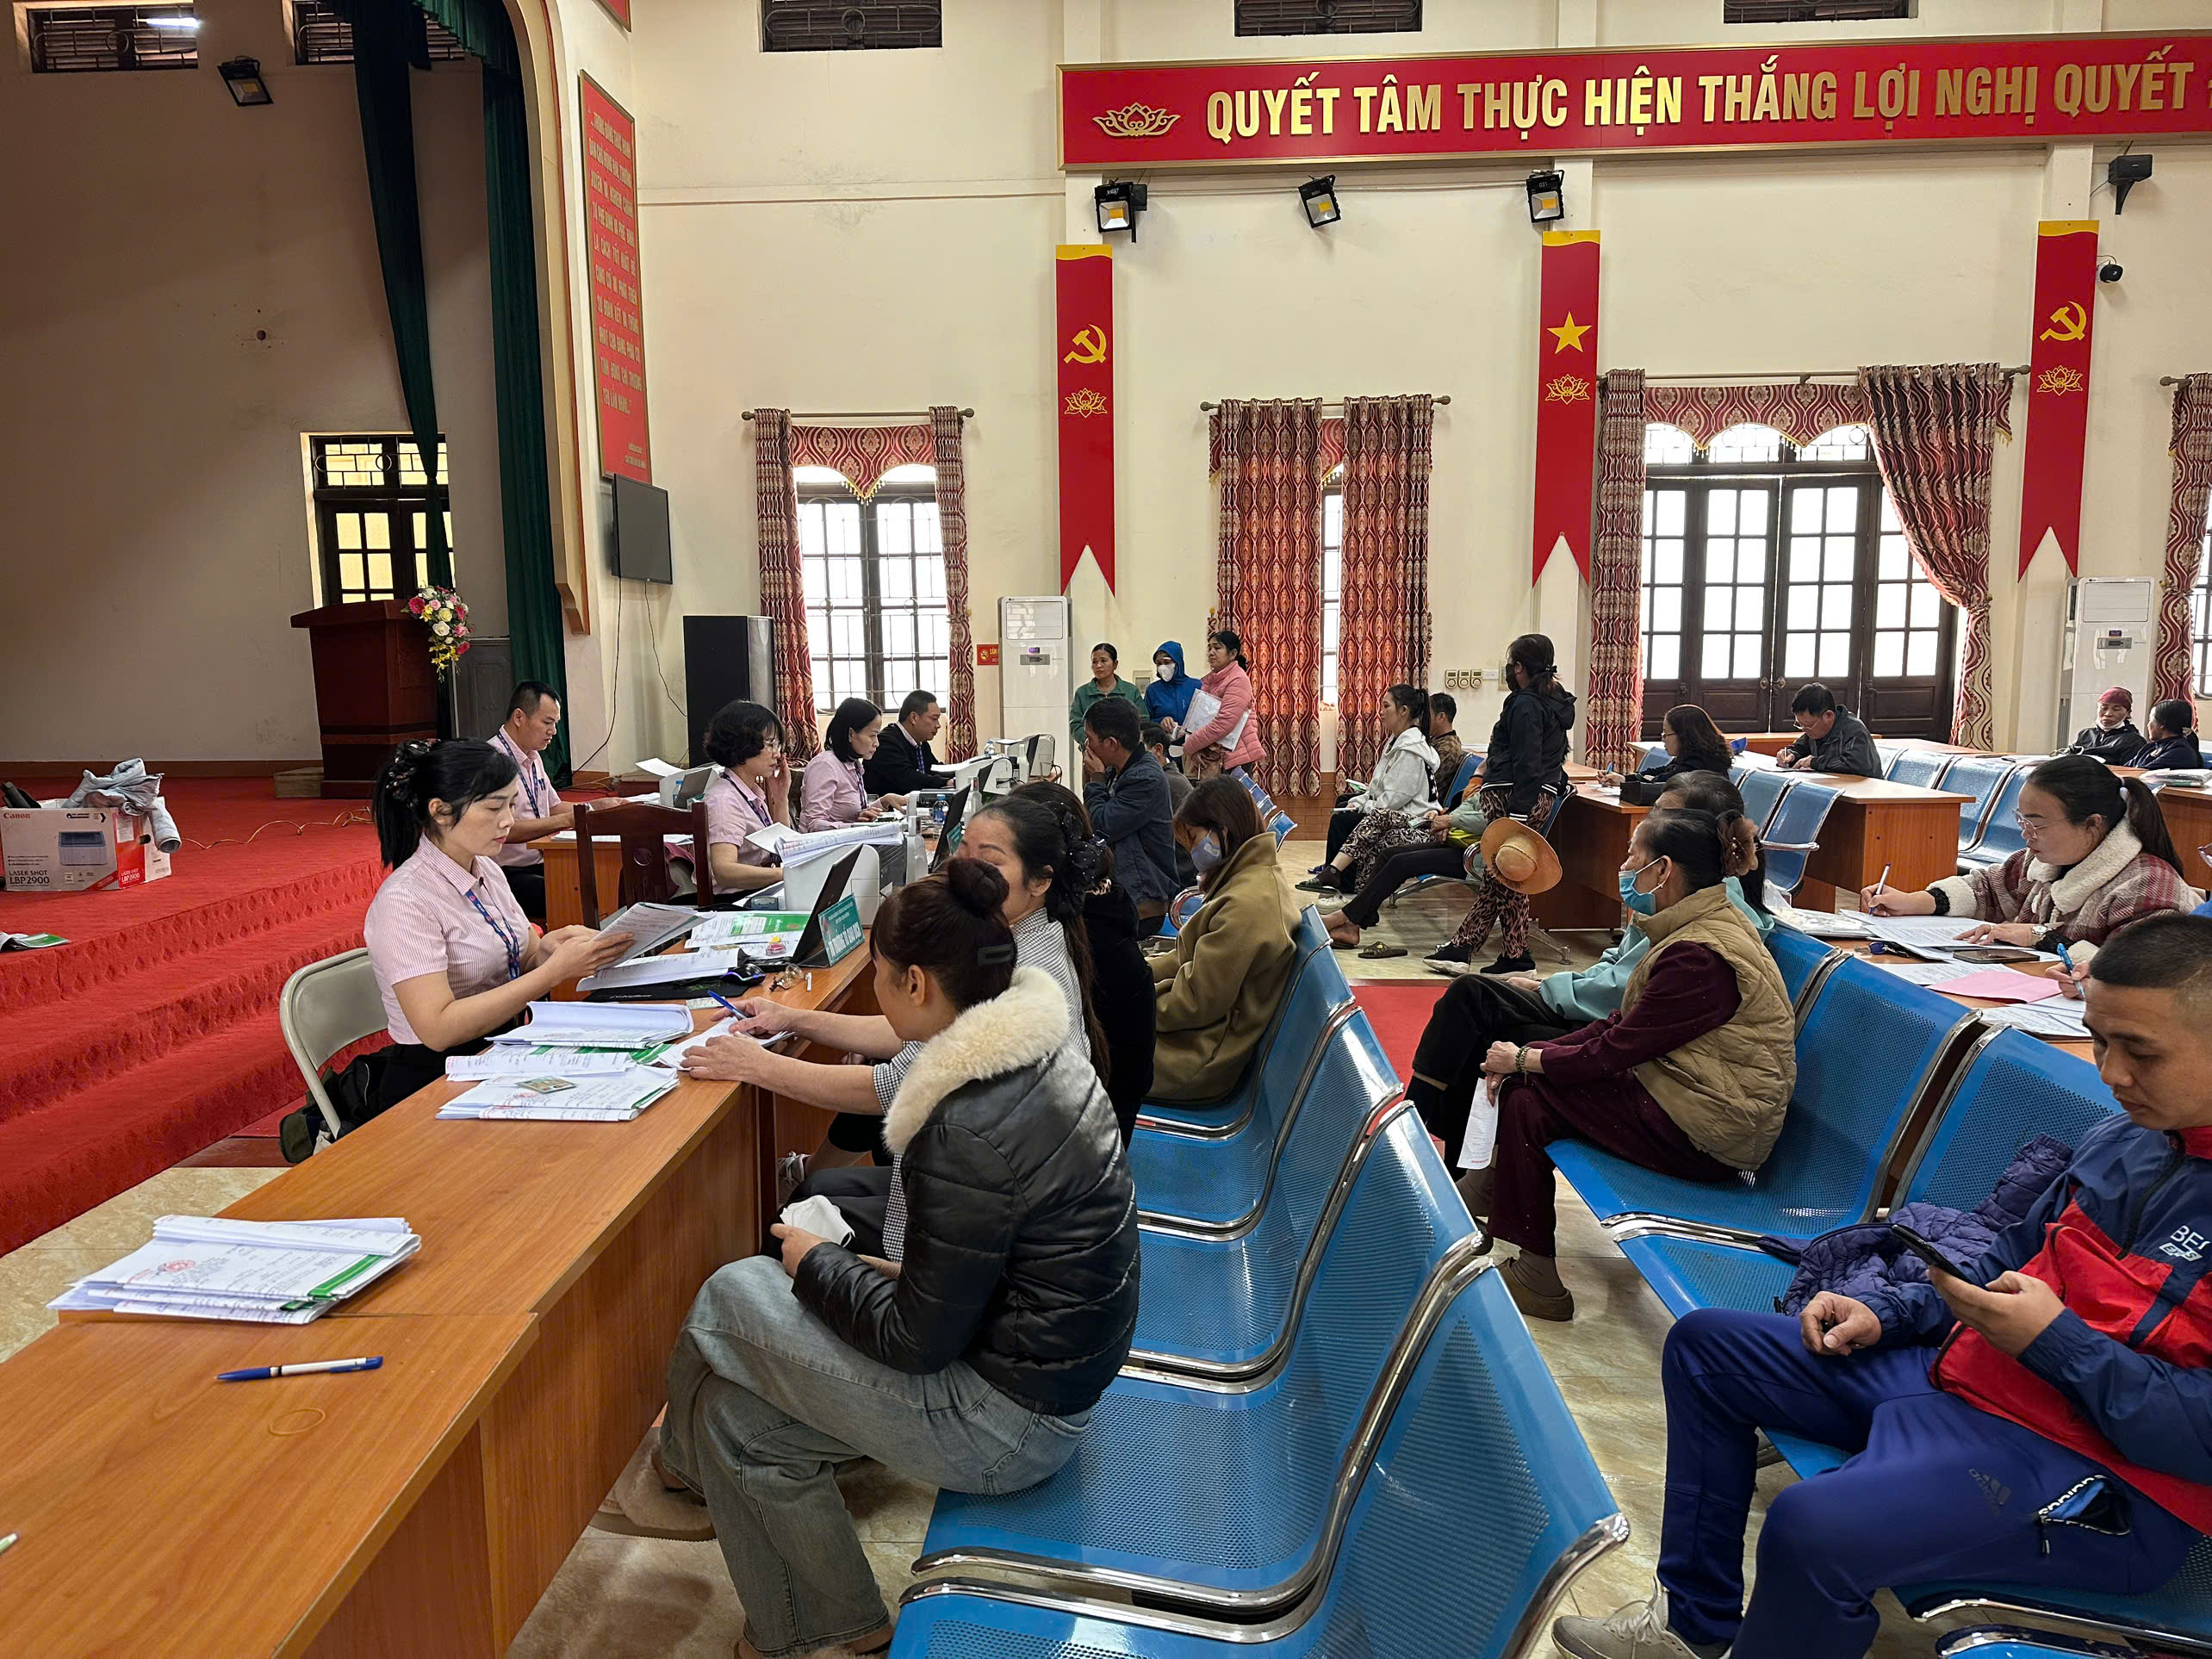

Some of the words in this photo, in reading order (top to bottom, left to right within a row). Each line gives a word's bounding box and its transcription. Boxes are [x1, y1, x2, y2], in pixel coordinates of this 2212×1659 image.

[1207, 71, 1339, 144] QUYẾT
[1354, 74, 1441, 134] TÂM
[1457, 74, 1568, 140] THỰC
[1584, 65, 1682, 136] HIỆN
[1699, 54, 1837, 123] THẮNG
[1854, 63, 1921, 130] LỢI
[1935, 66, 2038, 125] NGHỊ
[2054, 45, 2194, 118] QUYẾT
